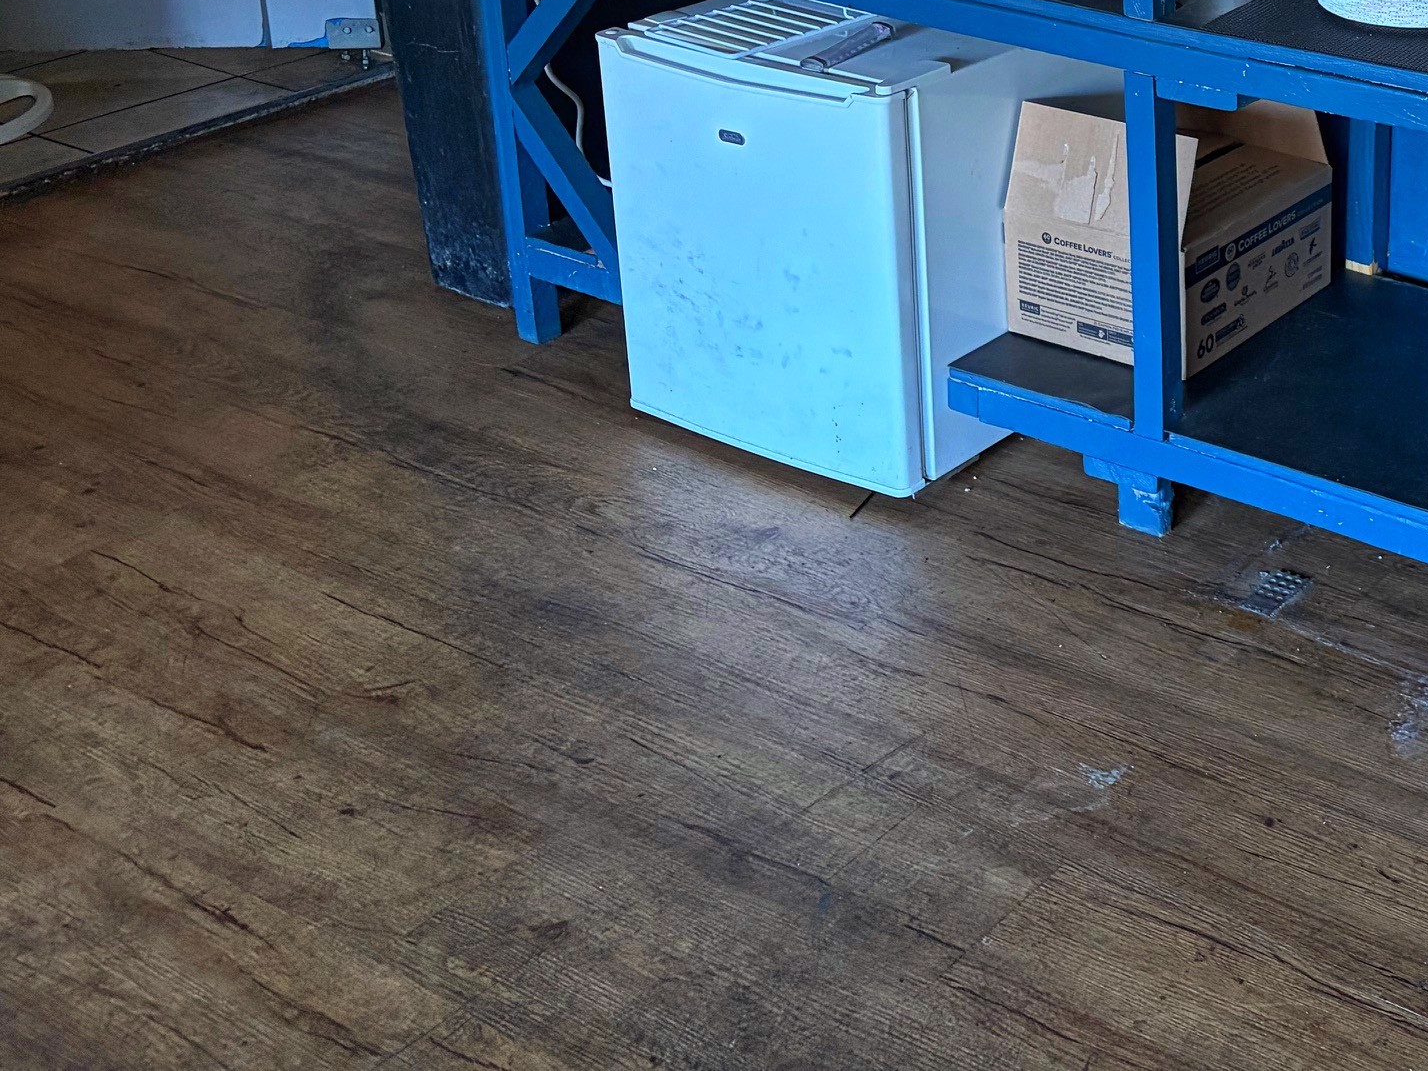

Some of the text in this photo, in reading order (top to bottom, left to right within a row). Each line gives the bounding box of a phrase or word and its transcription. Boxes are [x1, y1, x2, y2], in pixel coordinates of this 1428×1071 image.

[1054, 237, 1082, 250] COFFEE
[1113, 255, 1130, 264] COLLEC
[1238, 231, 1267, 252] COFFEE
[1196, 333, 1215, 359] 60
